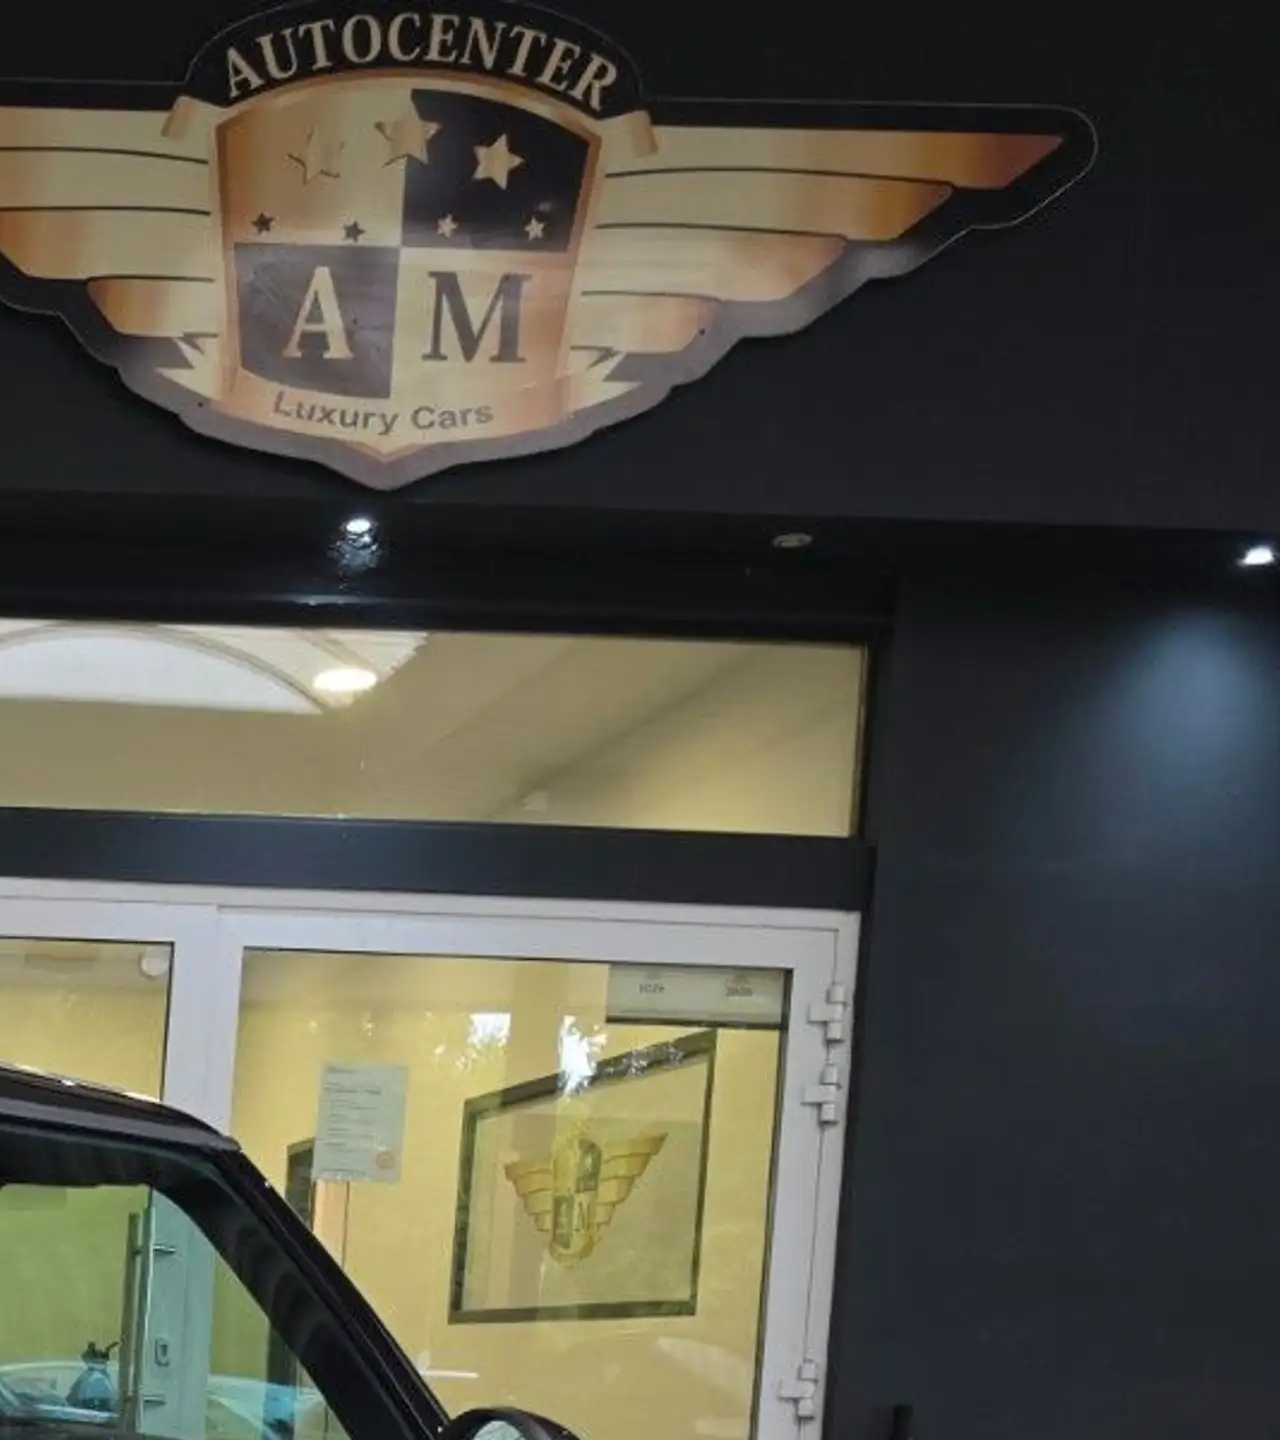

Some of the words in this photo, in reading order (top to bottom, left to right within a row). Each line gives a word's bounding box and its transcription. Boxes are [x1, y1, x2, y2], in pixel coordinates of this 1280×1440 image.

[224, 12, 619, 112] AUTOCENTER
[281, 264, 355, 361] A
[421, 270, 532, 364] M
[272, 390, 399, 436] Luxury
[410, 403, 495, 431] Cars
